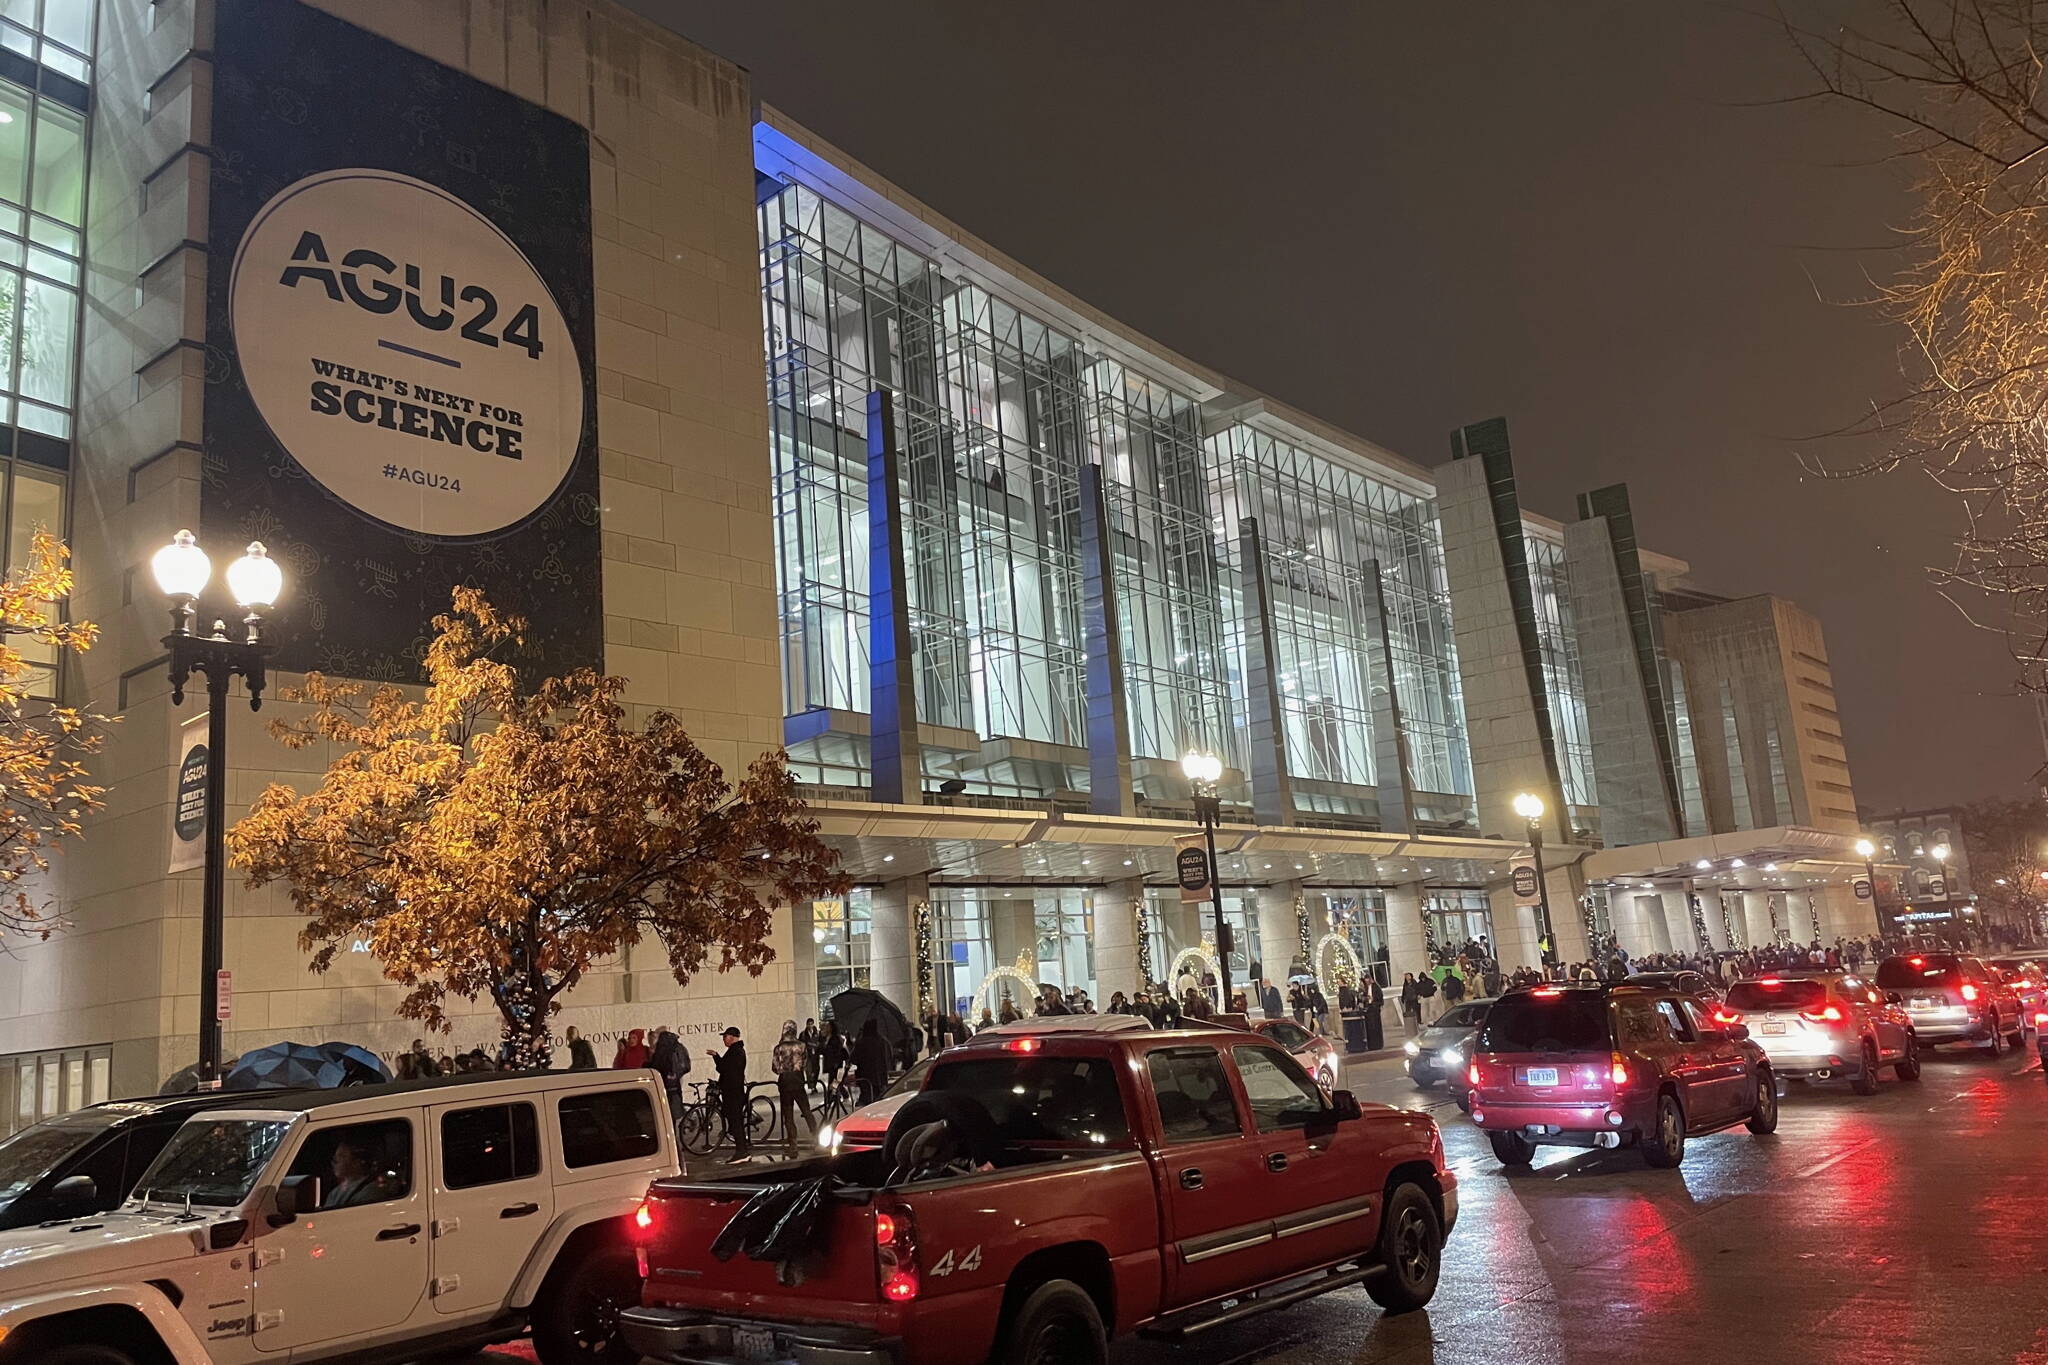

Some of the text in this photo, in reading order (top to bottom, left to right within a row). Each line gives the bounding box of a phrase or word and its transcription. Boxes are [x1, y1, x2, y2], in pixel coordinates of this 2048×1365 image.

[279, 230, 544, 360] AGU24
[311, 357, 524, 427] WHAT'S NEXT FOR
[310, 380, 522, 460] SCIENCE
[382, 463, 462, 493] #AGU24
[182, 764, 207, 784] AGU24
[1181, 856, 1203, 864] AGU24
[583, 1025, 671, 1046] CONVET
[678, 1022, 724, 1036] CENTER
[382, 1045, 445, 1063] WAER
[207, 1318, 246, 1333] Jeep
